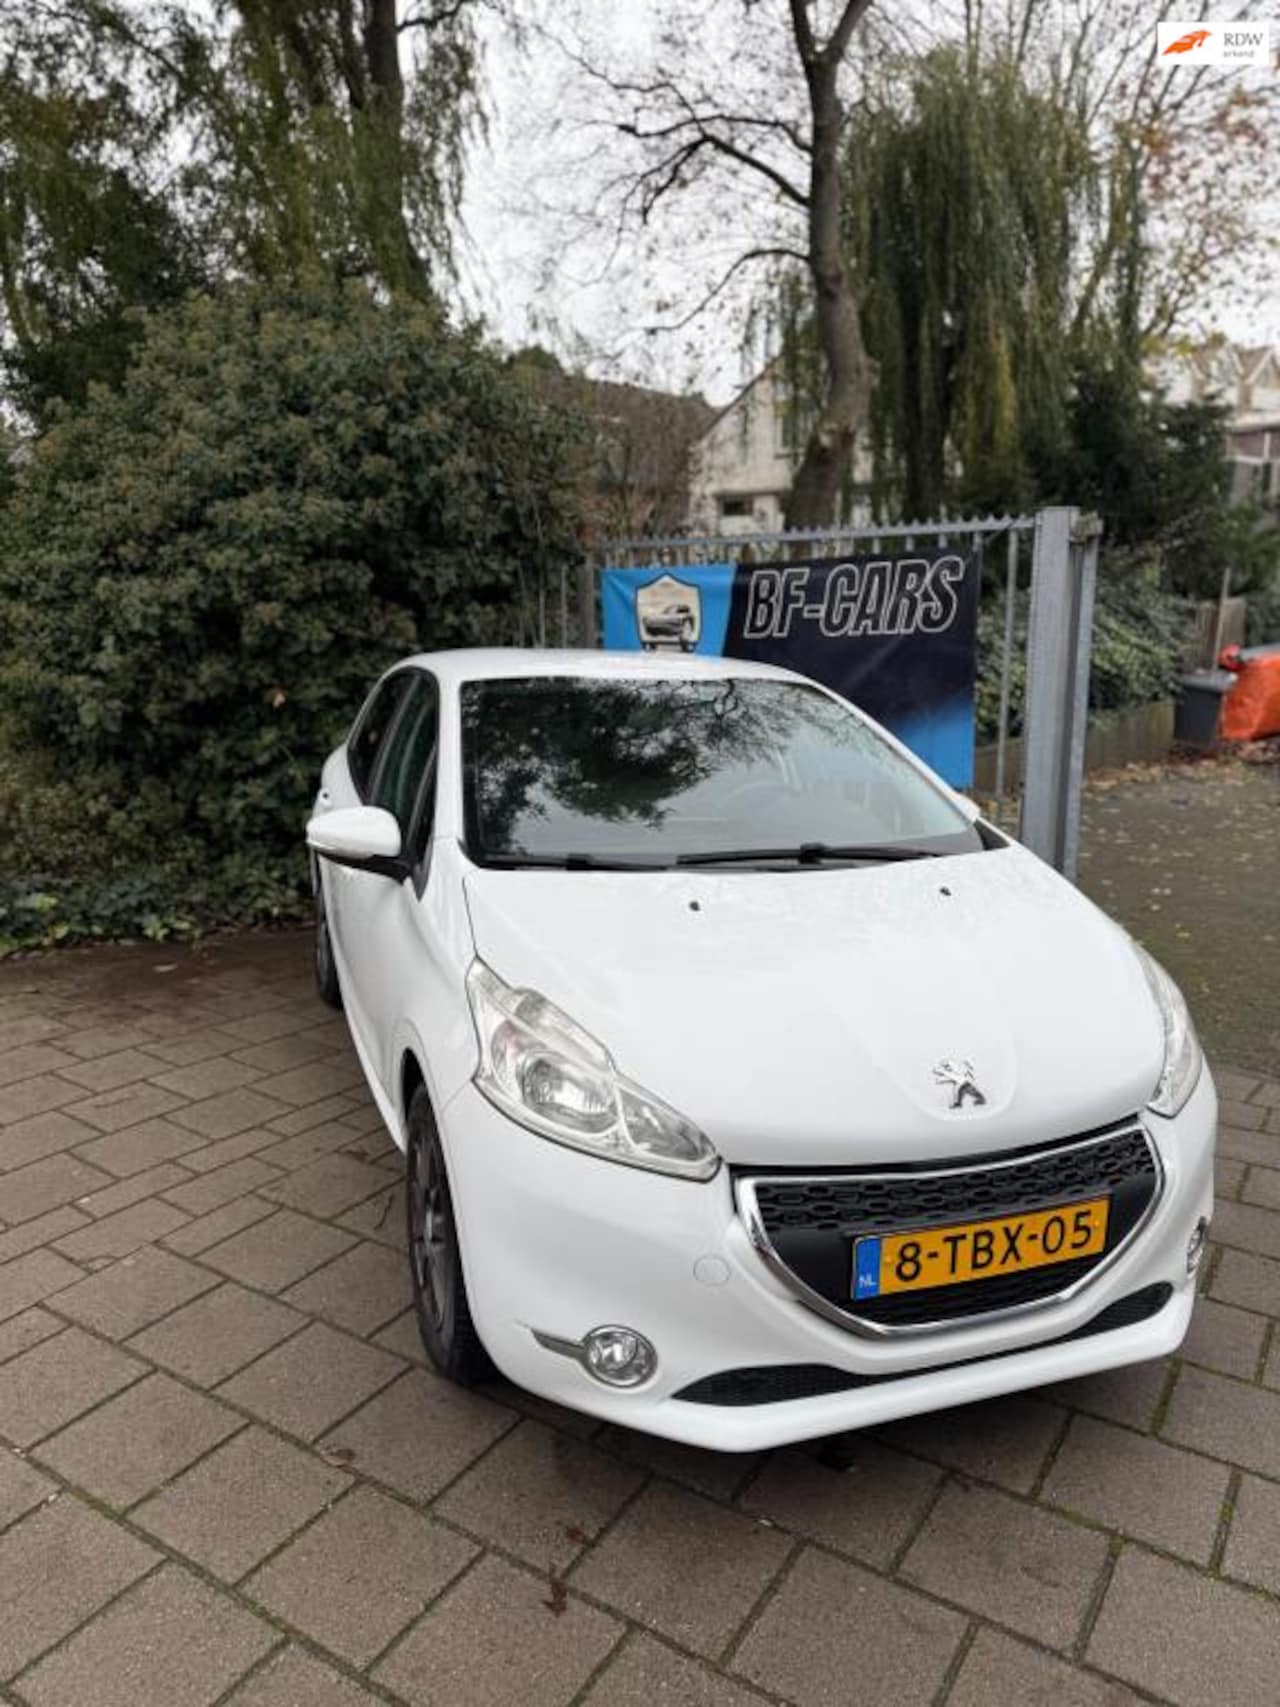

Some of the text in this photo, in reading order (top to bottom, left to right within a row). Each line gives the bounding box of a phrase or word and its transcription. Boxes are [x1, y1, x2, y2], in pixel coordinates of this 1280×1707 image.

[744, 555, 964, 639] BF-CARS
[858, 1274, 877, 1289] NL
[895, 1210, 1092, 1282] 8-TBX-05
